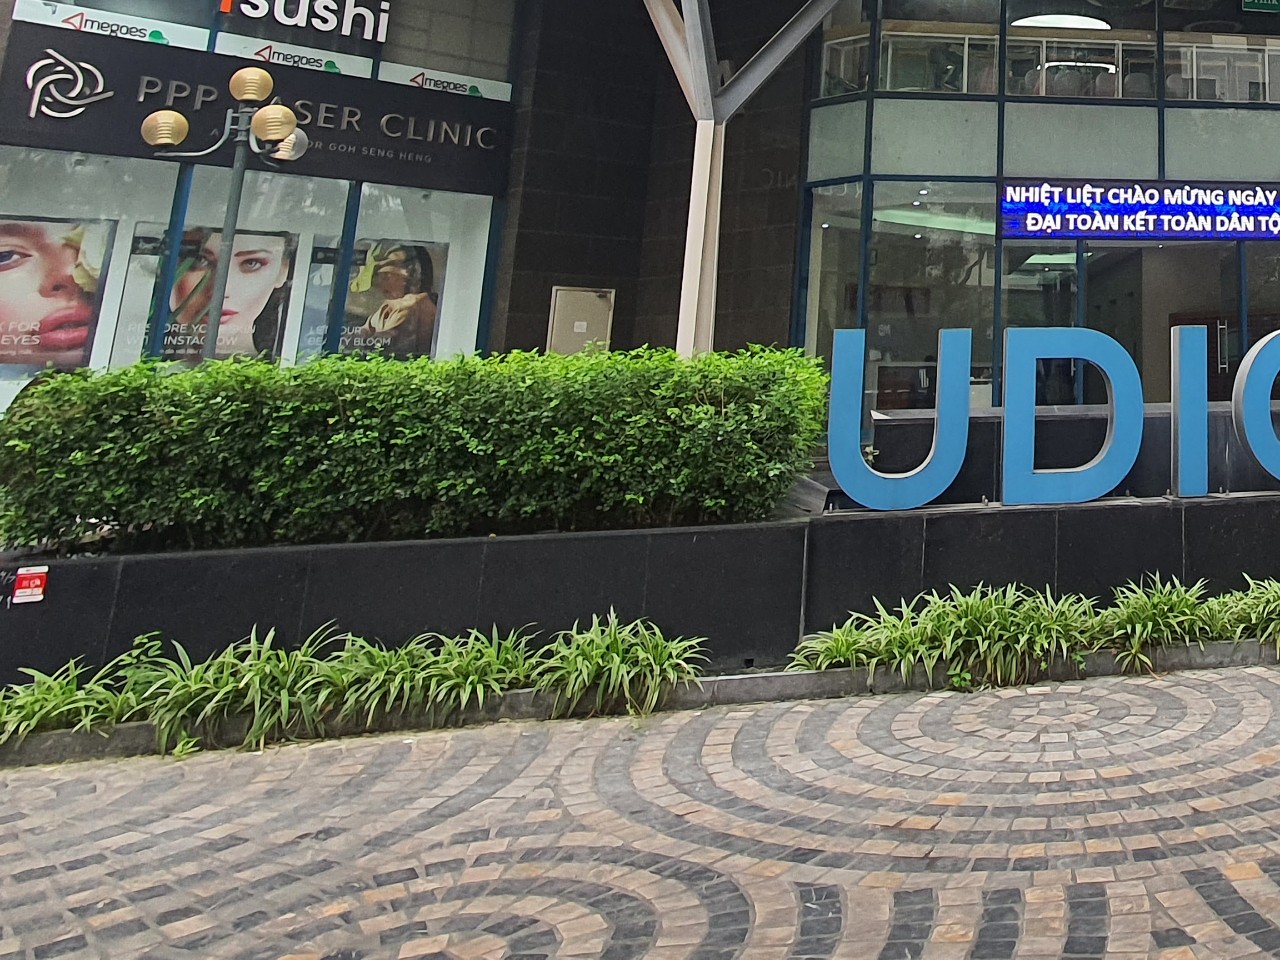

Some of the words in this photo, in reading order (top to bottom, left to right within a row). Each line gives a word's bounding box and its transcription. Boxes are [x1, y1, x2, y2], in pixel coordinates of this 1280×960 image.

[136, 75, 219, 110] PPP
[379, 113, 497, 150] CLINIC
[328, 142, 357, 153] GOH
[361, 146, 394, 159] SENG
[399, 151, 432, 164] HENG
[1006, 183, 1063, 207] NHIỆT
[1066, 184, 1104, 207] LIỆT
[1107, 185, 1160, 204] CHÀO
[1163, 185, 1224, 205] MỪNG
[1228, 186, 1277, 206] NGÀY
[1026, 212, 1061, 234] ĐẠI
[1065, 210, 1119, 230] TOÀN
[1123, 210, 1157, 231] KẾT
[1160, 211, 1212, 231] TOÀN
[1215, 211, 1255, 232] DÂN
[8, 321, 40, 332] FOR
[1, 334, 41, 345] EYES
[353, 337, 392, 346] BLOOM
